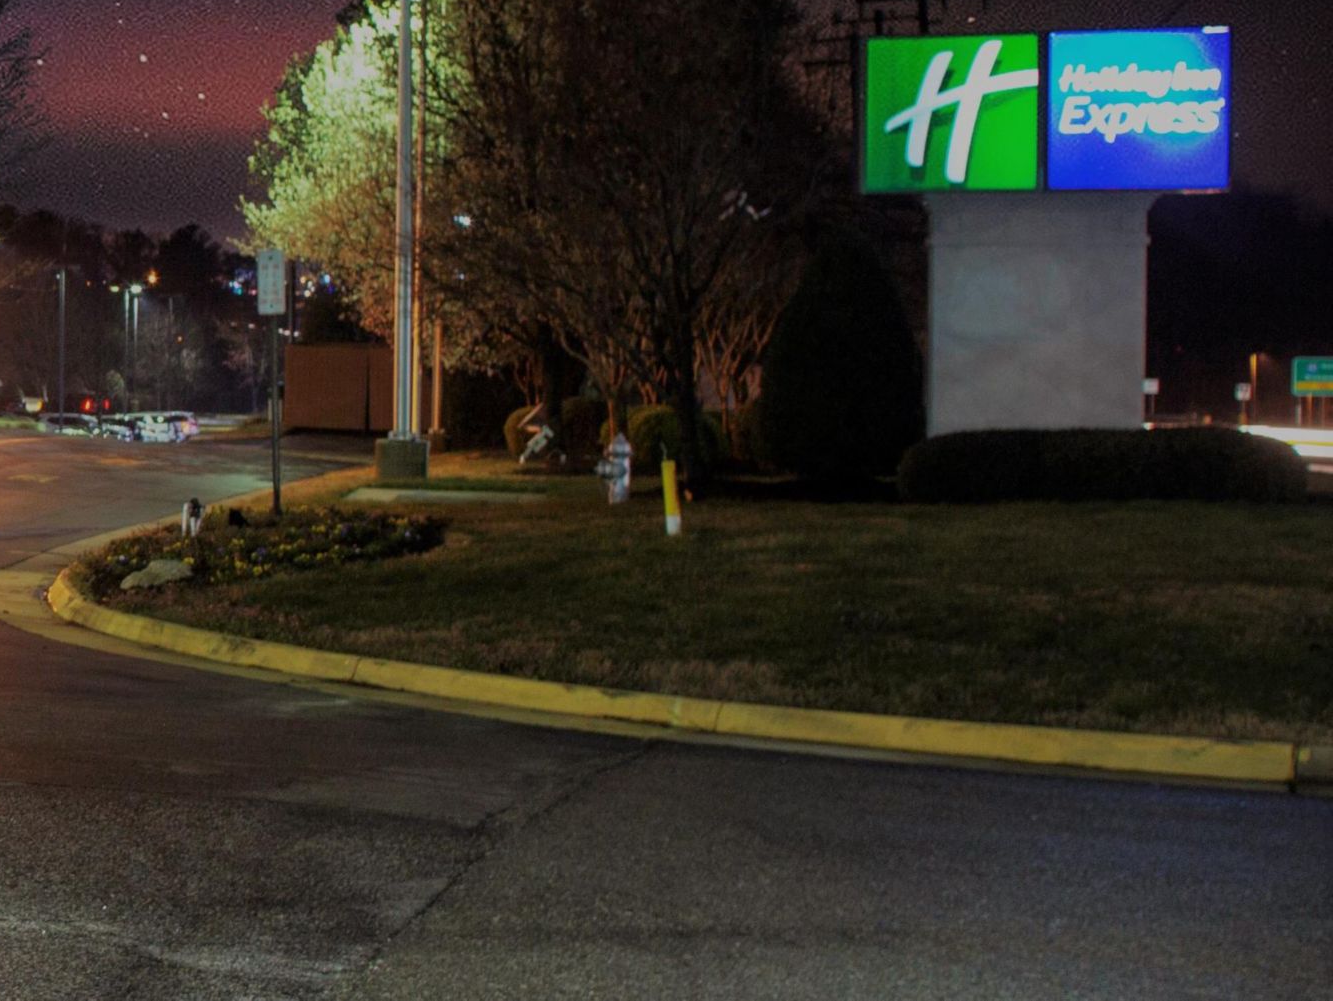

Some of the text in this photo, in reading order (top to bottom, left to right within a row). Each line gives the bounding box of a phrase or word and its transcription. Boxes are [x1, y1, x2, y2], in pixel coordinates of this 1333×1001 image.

[1058, 60, 1222, 98] Holiday Inn
[1058, 96, 1222, 143] Express
